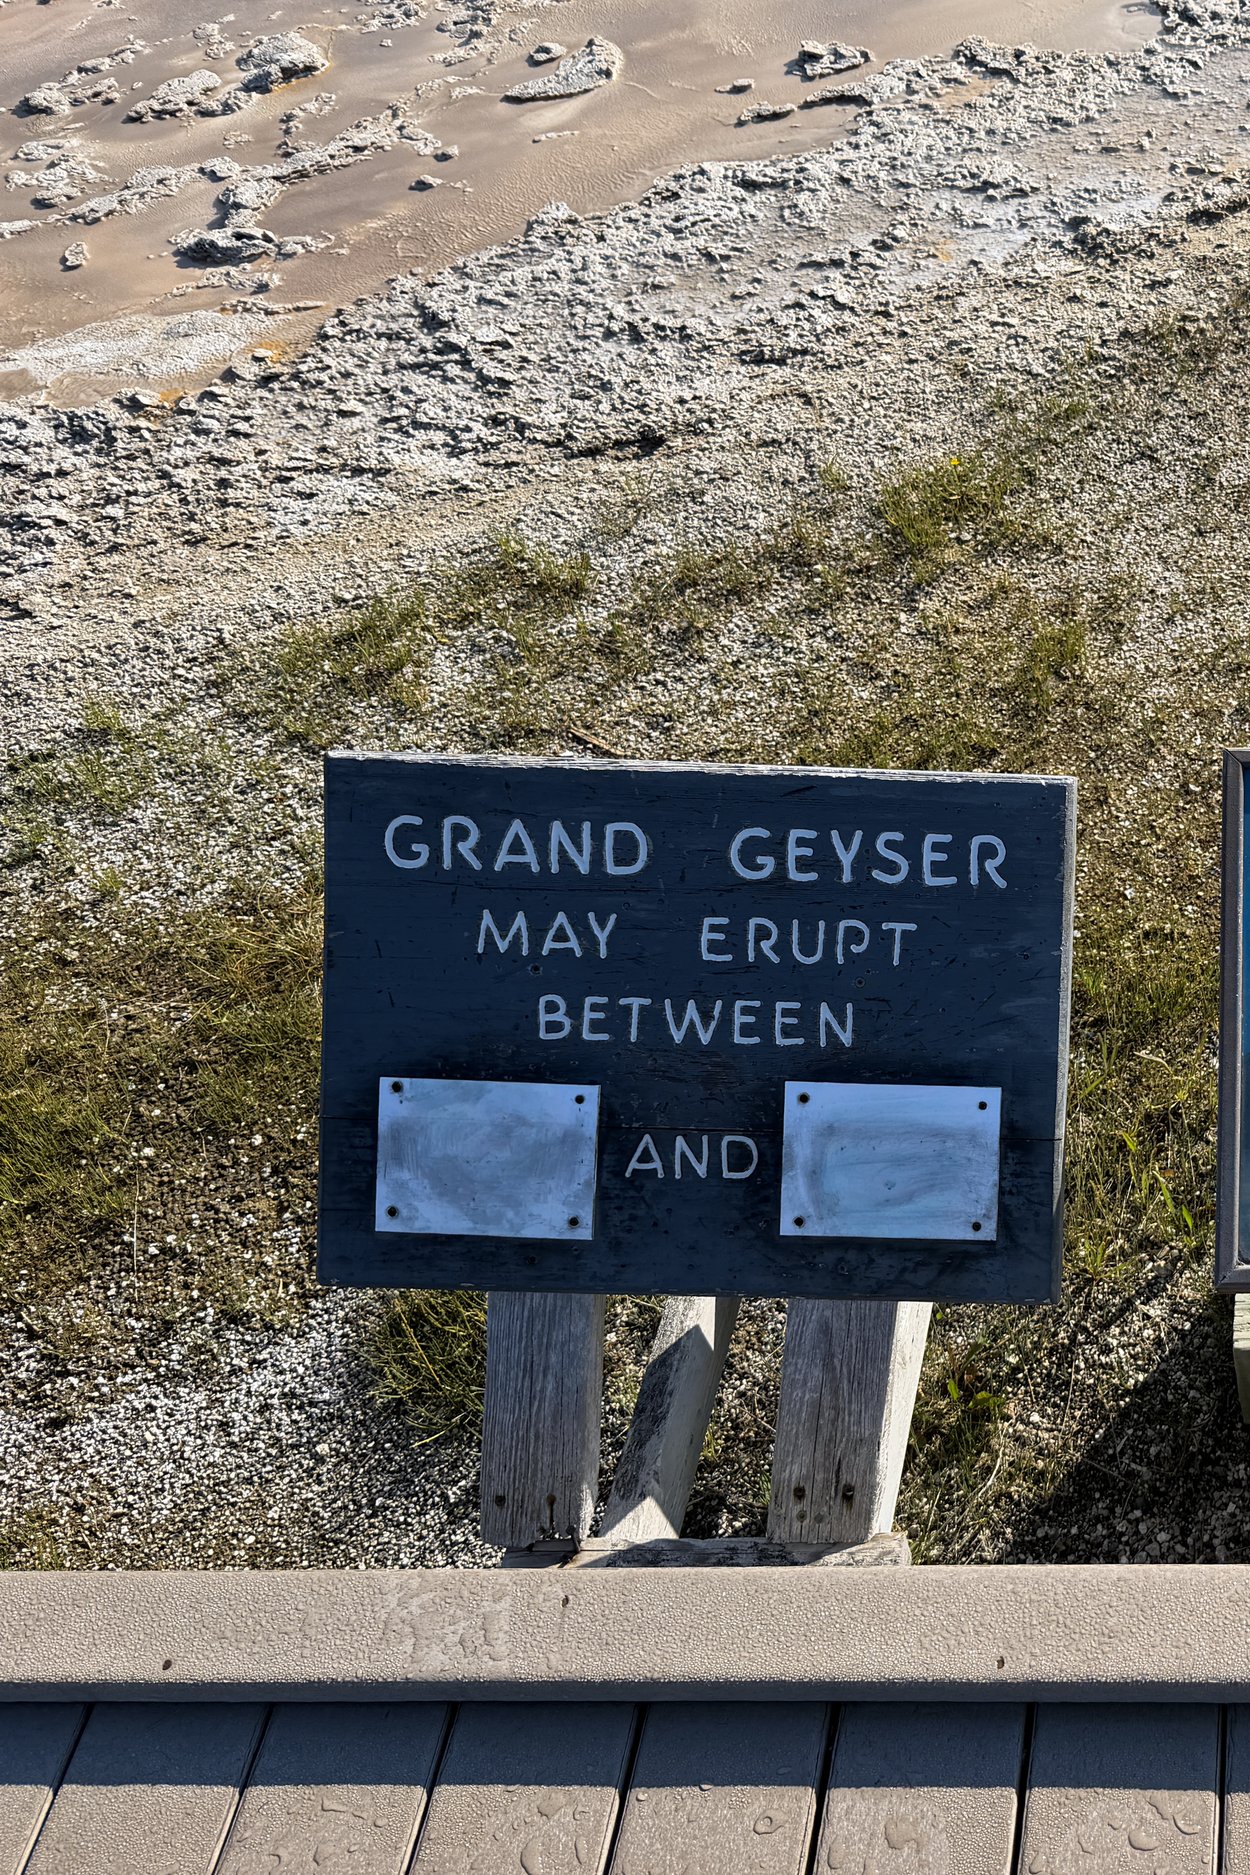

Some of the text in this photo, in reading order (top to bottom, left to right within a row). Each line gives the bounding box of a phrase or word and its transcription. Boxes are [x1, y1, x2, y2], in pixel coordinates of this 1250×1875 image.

[384, 814, 1008, 889] GRAND GEYSER
[477, 909, 918, 967] MAY ERUPT
[538, 994, 853, 1048] BETWEEN
[625, 1133, 758, 1179] AND
